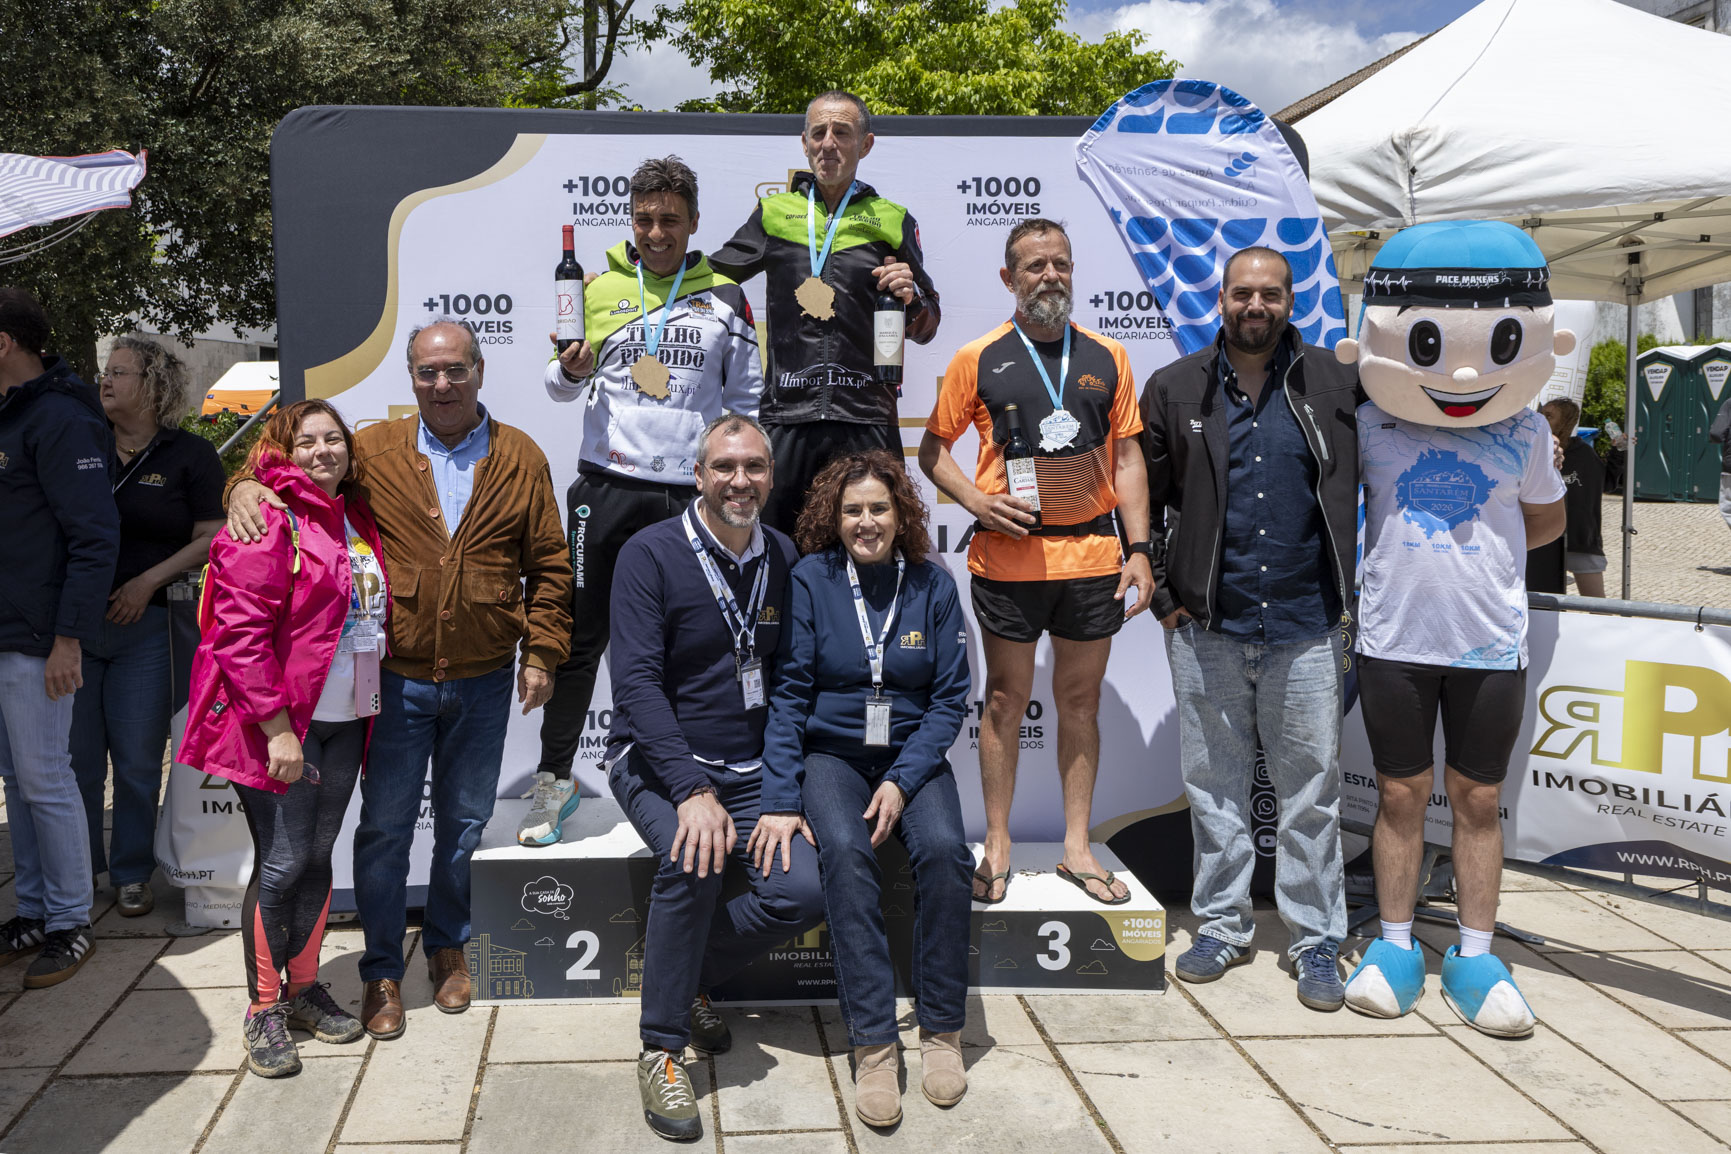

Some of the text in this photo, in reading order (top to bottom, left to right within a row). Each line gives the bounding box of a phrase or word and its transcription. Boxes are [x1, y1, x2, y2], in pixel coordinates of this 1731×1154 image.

[562, 175, 630, 197] +100
[957, 176, 1041, 197] +1000
[573, 199, 631, 215] IMÓVE
[966, 199, 1041, 215] IMÓVEIS
[573, 218, 633, 227] ANGARIAD
[1435, 275, 1500, 285] PACE MAKERS
[423, 294, 513, 315] +1000
[1099, 314, 1172, 329] IMÓVEIS
[477, 336, 514, 345] IADOS
[620, 348, 706, 368] PEDIDO
[1413, 487, 1469, 497] SANTARÉM
[1431, 503, 1454, 511] 2026
[576, 520, 586, 589] PROCURAME
[1344, 772, 1379, 790] ESTA
[1532, 769, 1731, 818] IMOBILIÁ
[1597, 804, 1727, 837] REAL ESTATE
[537, 887, 566, 903] sonho
[203, 901, 242, 910] MEDIAÇÃO
[1122, 918, 1162, 928] +1000
[1122, 929, 1162, 937] IMÓVEIS
[1036, 920, 1071, 971] 3
[565, 930, 600, 981] 2
[769, 951, 833, 961] IMOBILI
